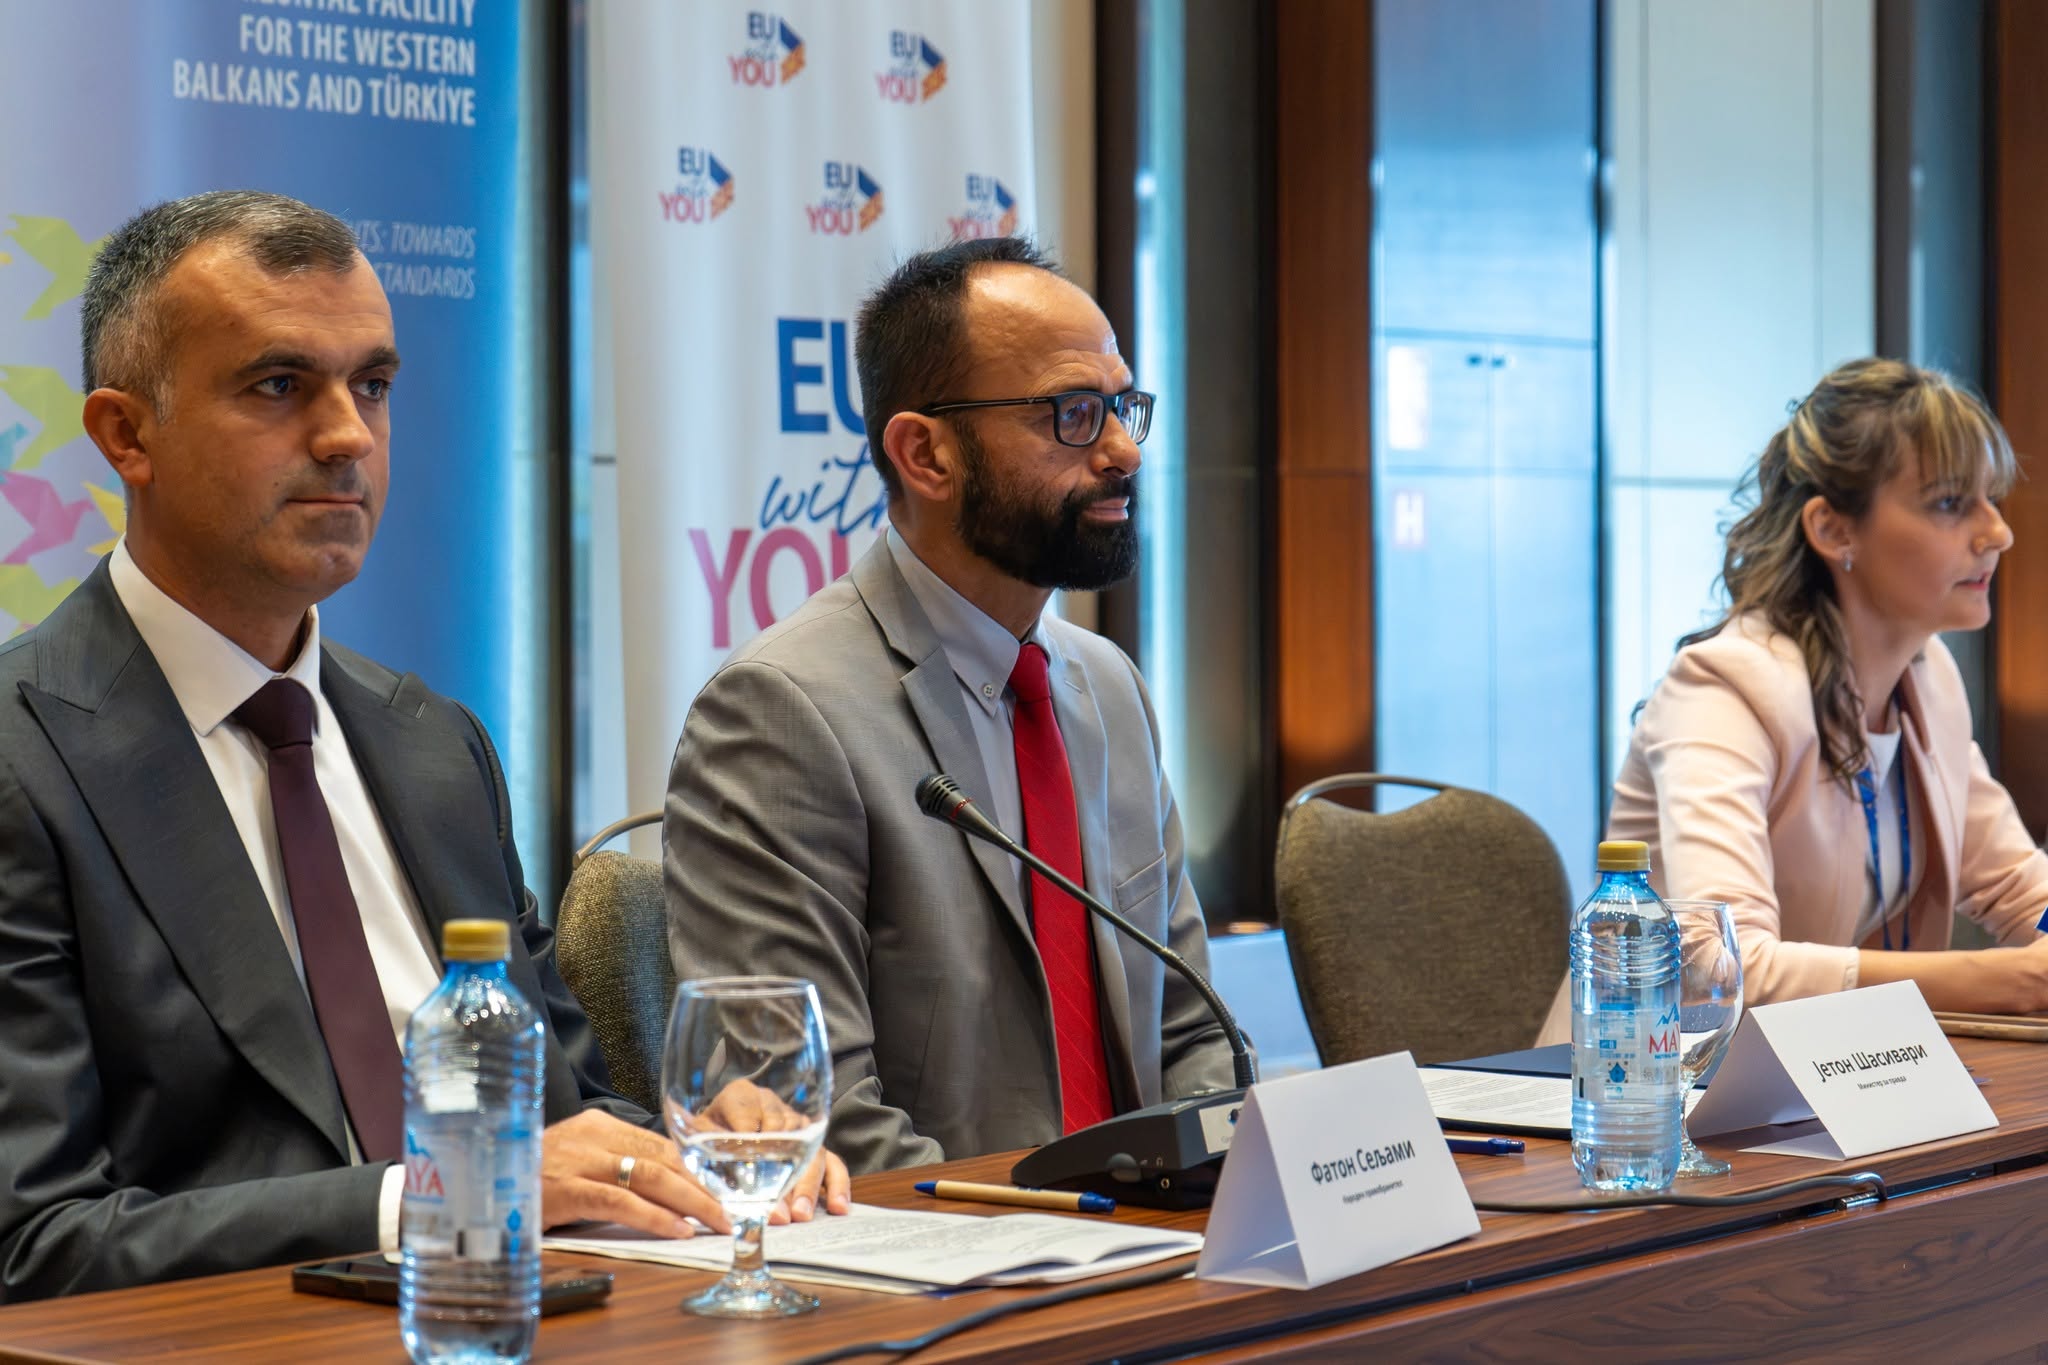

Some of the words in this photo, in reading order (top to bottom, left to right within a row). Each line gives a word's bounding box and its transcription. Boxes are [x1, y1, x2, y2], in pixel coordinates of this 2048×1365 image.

[748, 11, 775, 40] EU
[240, 15, 292, 57] FOR
[298, 20, 348, 63] THE
[354, 27, 476, 77] WESTERN
[891, 30, 917, 57] EU
[727, 55, 775, 87] YOU
[173, 58, 300, 109] BALKANS
[306, 72, 363, 115] AND
[367, 73, 476, 127] TÜRKİYE
[876, 73, 917, 104] YOU
[678, 147, 704, 176] EU
[824, 162, 852, 189] EU
[966, 174, 992, 201] EU
[658, 192, 704, 223] YOU
[805, 205, 852, 235] YOU
[391, 222, 476, 259] TOWARDS
[688, 527, 851, 649] YO
[1812, 1058, 1855, 1083] Јетон
[1850, 1042, 1928, 1070] Шасивари
[1311, 1158, 1357, 1184] Фатон
[1356, 1140, 1415, 1172] Сељами
